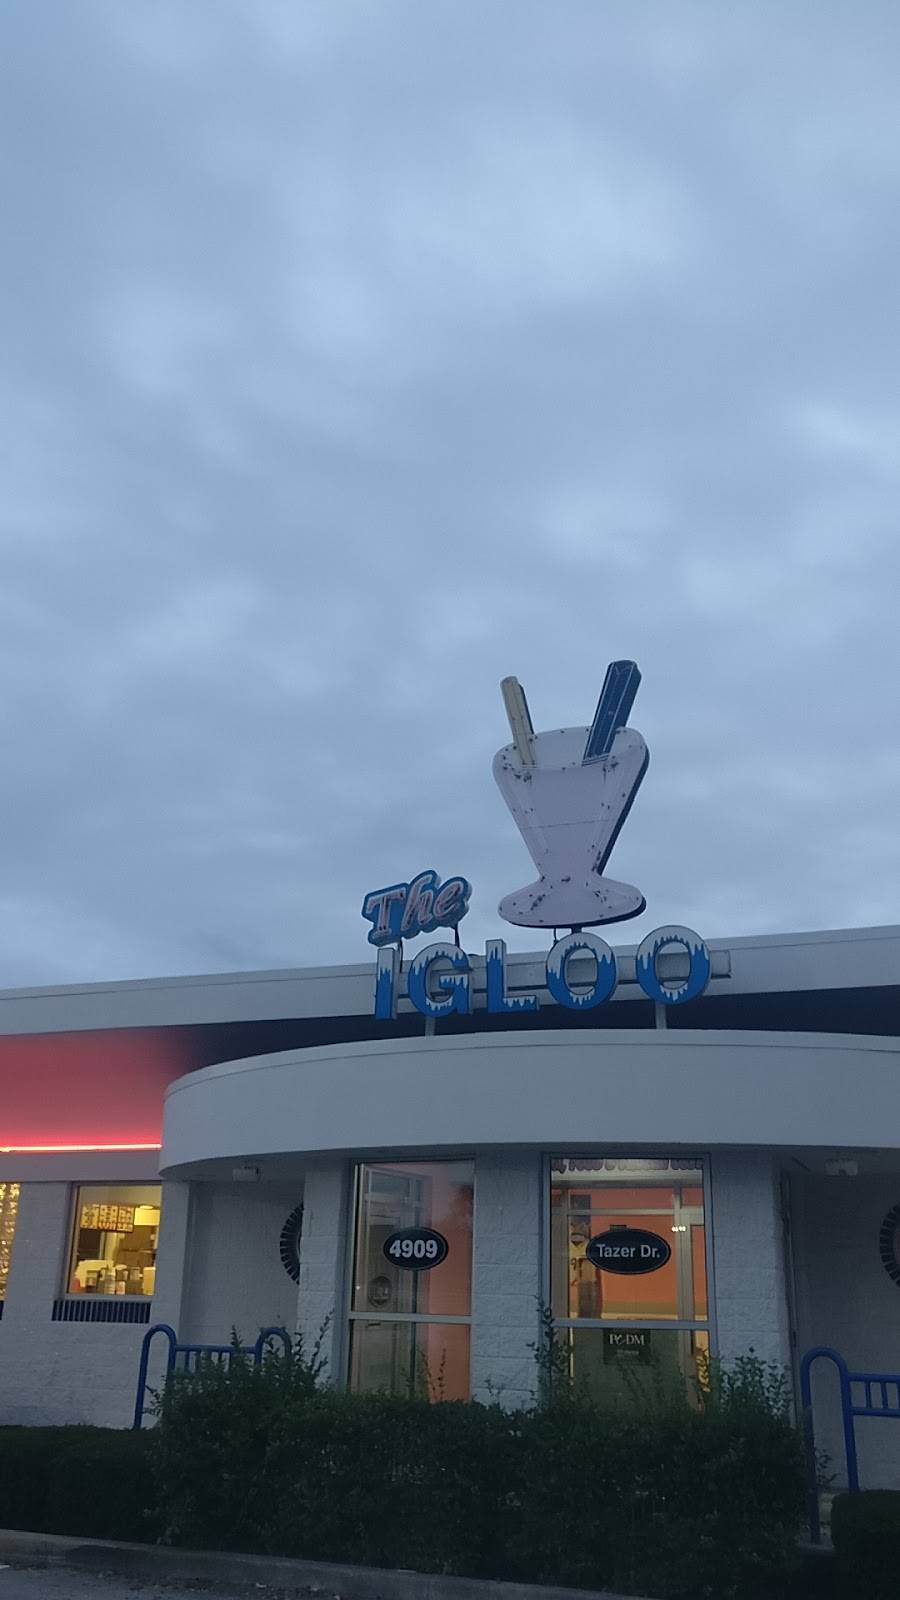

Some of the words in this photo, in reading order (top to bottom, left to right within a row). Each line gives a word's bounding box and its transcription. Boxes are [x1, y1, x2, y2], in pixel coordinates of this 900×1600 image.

[364, 872, 468, 940] The
[374, 925, 712, 1020] IGLOO
[389, 1239, 438, 1259] 4909
[596, 1243, 636, 1258] Tazer
[640, 1244, 661, 1259] Dr.
